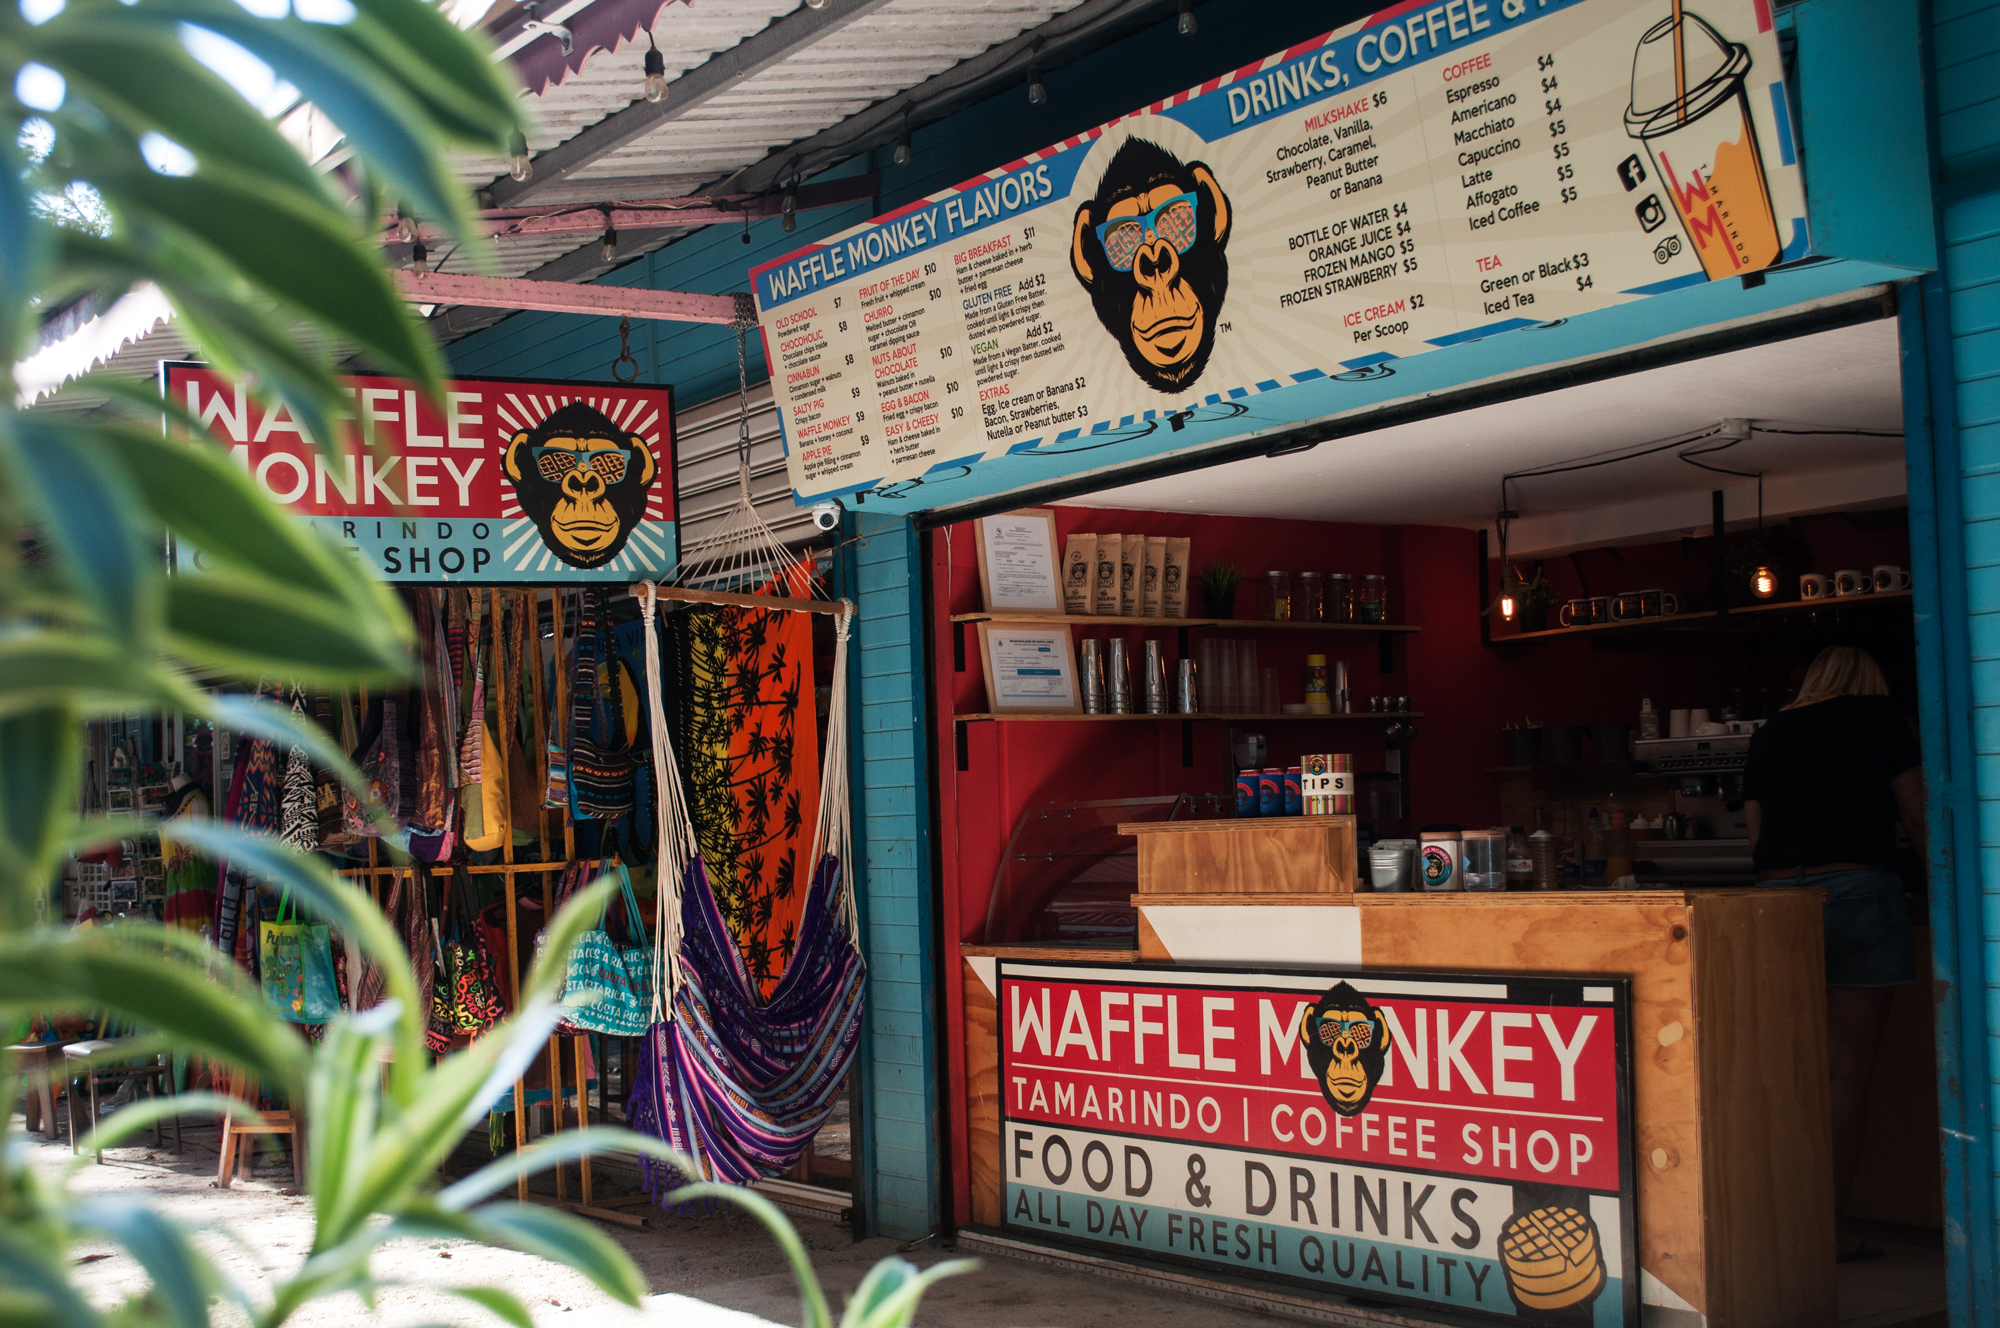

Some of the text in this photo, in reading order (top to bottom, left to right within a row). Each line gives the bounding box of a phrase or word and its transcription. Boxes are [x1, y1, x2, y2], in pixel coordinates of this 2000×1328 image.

[1227, 0, 1491, 124] DRINKS, COFFEE
[1442, 52, 1492, 82] COFFEE
[1445, 53, 1554, 104] Espresso $4
[1304, 90, 1388, 133] MILKSHAKE $6
[1451, 75, 1558, 125] Americano $4
[1276, 118, 1373, 161] Chocolate, Vanilla,
[1453, 97, 1562, 146] Macchiato $4
[1266, 134, 1376, 184] Strawberry, Caramel,
[1457, 119, 1566, 167] Capuccino $5
[1305, 155, 1379, 189] Peanut Butter
[1461, 141, 1570, 189] Latte $5
[1329, 174, 1383, 200] or Banana
[1466, 163, 1574, 210] Affogato $5
[1288, 201, 1408, 251] BOTTLE OF WATER $4
[1468, 185, 1578, 231] Iced Coffee $5
[1700, 164, 1749, 264] TAMARINDO
[768, 164, 1053, 301] WAFFLE MONKEY FLAVORS
[953, 226, 1035, 265] BIG BREAKFAST $11
[1308, 220, 1411, 263] ORANGE JUICE $4
[1303, 238, 1415, 283] FROZEN MANGO $5
[1475, 254, 1502, 272] TEA
[1480, 252, 1589, 294] Green or Black $3
[858, 262, 937, 299] FRUIT OF THE DAY $10
[962, 273, 1046, 310] GLUTEN FREE Add $2
[1279, 256, 1418, 308] FROZEN STRAWBERRY $5
[1483, 274, 1593, 315] Iced Tea $4
[775, 296, 841, 330] OLD SCHOOL $7
[863, 287, 942, 323] CHURRO $10
[1343, 293, 1425, 327] ICE CREAM $2
[777, 322, 811, 338] Powdered sugar
[780, 320, 848, 353] CHOCOHOLIC $8
[970, 320, 1054, 356] VEGAN Add $2
[1353, 320, 1409, 344] Per Scoop
[782, 340, 828, 362] Chocolate chips inside
[786, 353, 854, 384] CINNABUN $8
[871, 342, 917, 366] NUTS ABOUT
[874, 345, 953, 379] CHOCOLATE $10
[792, 386, 861, 416] SALTY PIG $9
[880, 380, 959, 413] EGG & BACON $10
[979, 383, 1010, 401] EXTRAS
[981, 376, 1086, 418] Egg, Ice cream or Banana $2
[794, 412, 821, 425] Crispy bacon
[796, 410, 865, 439] WAFFLE MONKEY $9
[885, 406, 964, 437] EASY & CHEESY $10
[983, 400, 1060, 428] Bacon, Strawberries,
[986, 404, 1089, 441] Nutella or Peanut butter $3
[802, 434, 870, 462] APPLE PIE $9
[228, 444, 485, 507] ONKEY
[384, 547, 491, 574] SHOP
[1303, 778, 1344, 790] TIPS
[591, 1000, 621, 1018] COSTA
[1011, 985, 1599, 1101] WAFFLE MNKEY
[1012, 1076, 1221, 1134] TAMARINDO
[1271, 1103, 1436, 1159] COFFEE
[1462, 1122, 1593, 1175] SHOP
[1014, 1129, 1481, 1250] FOOD & DRINKS
[1013, 1188, 1491, 1302] ALL DAY FRESH QUALITY
